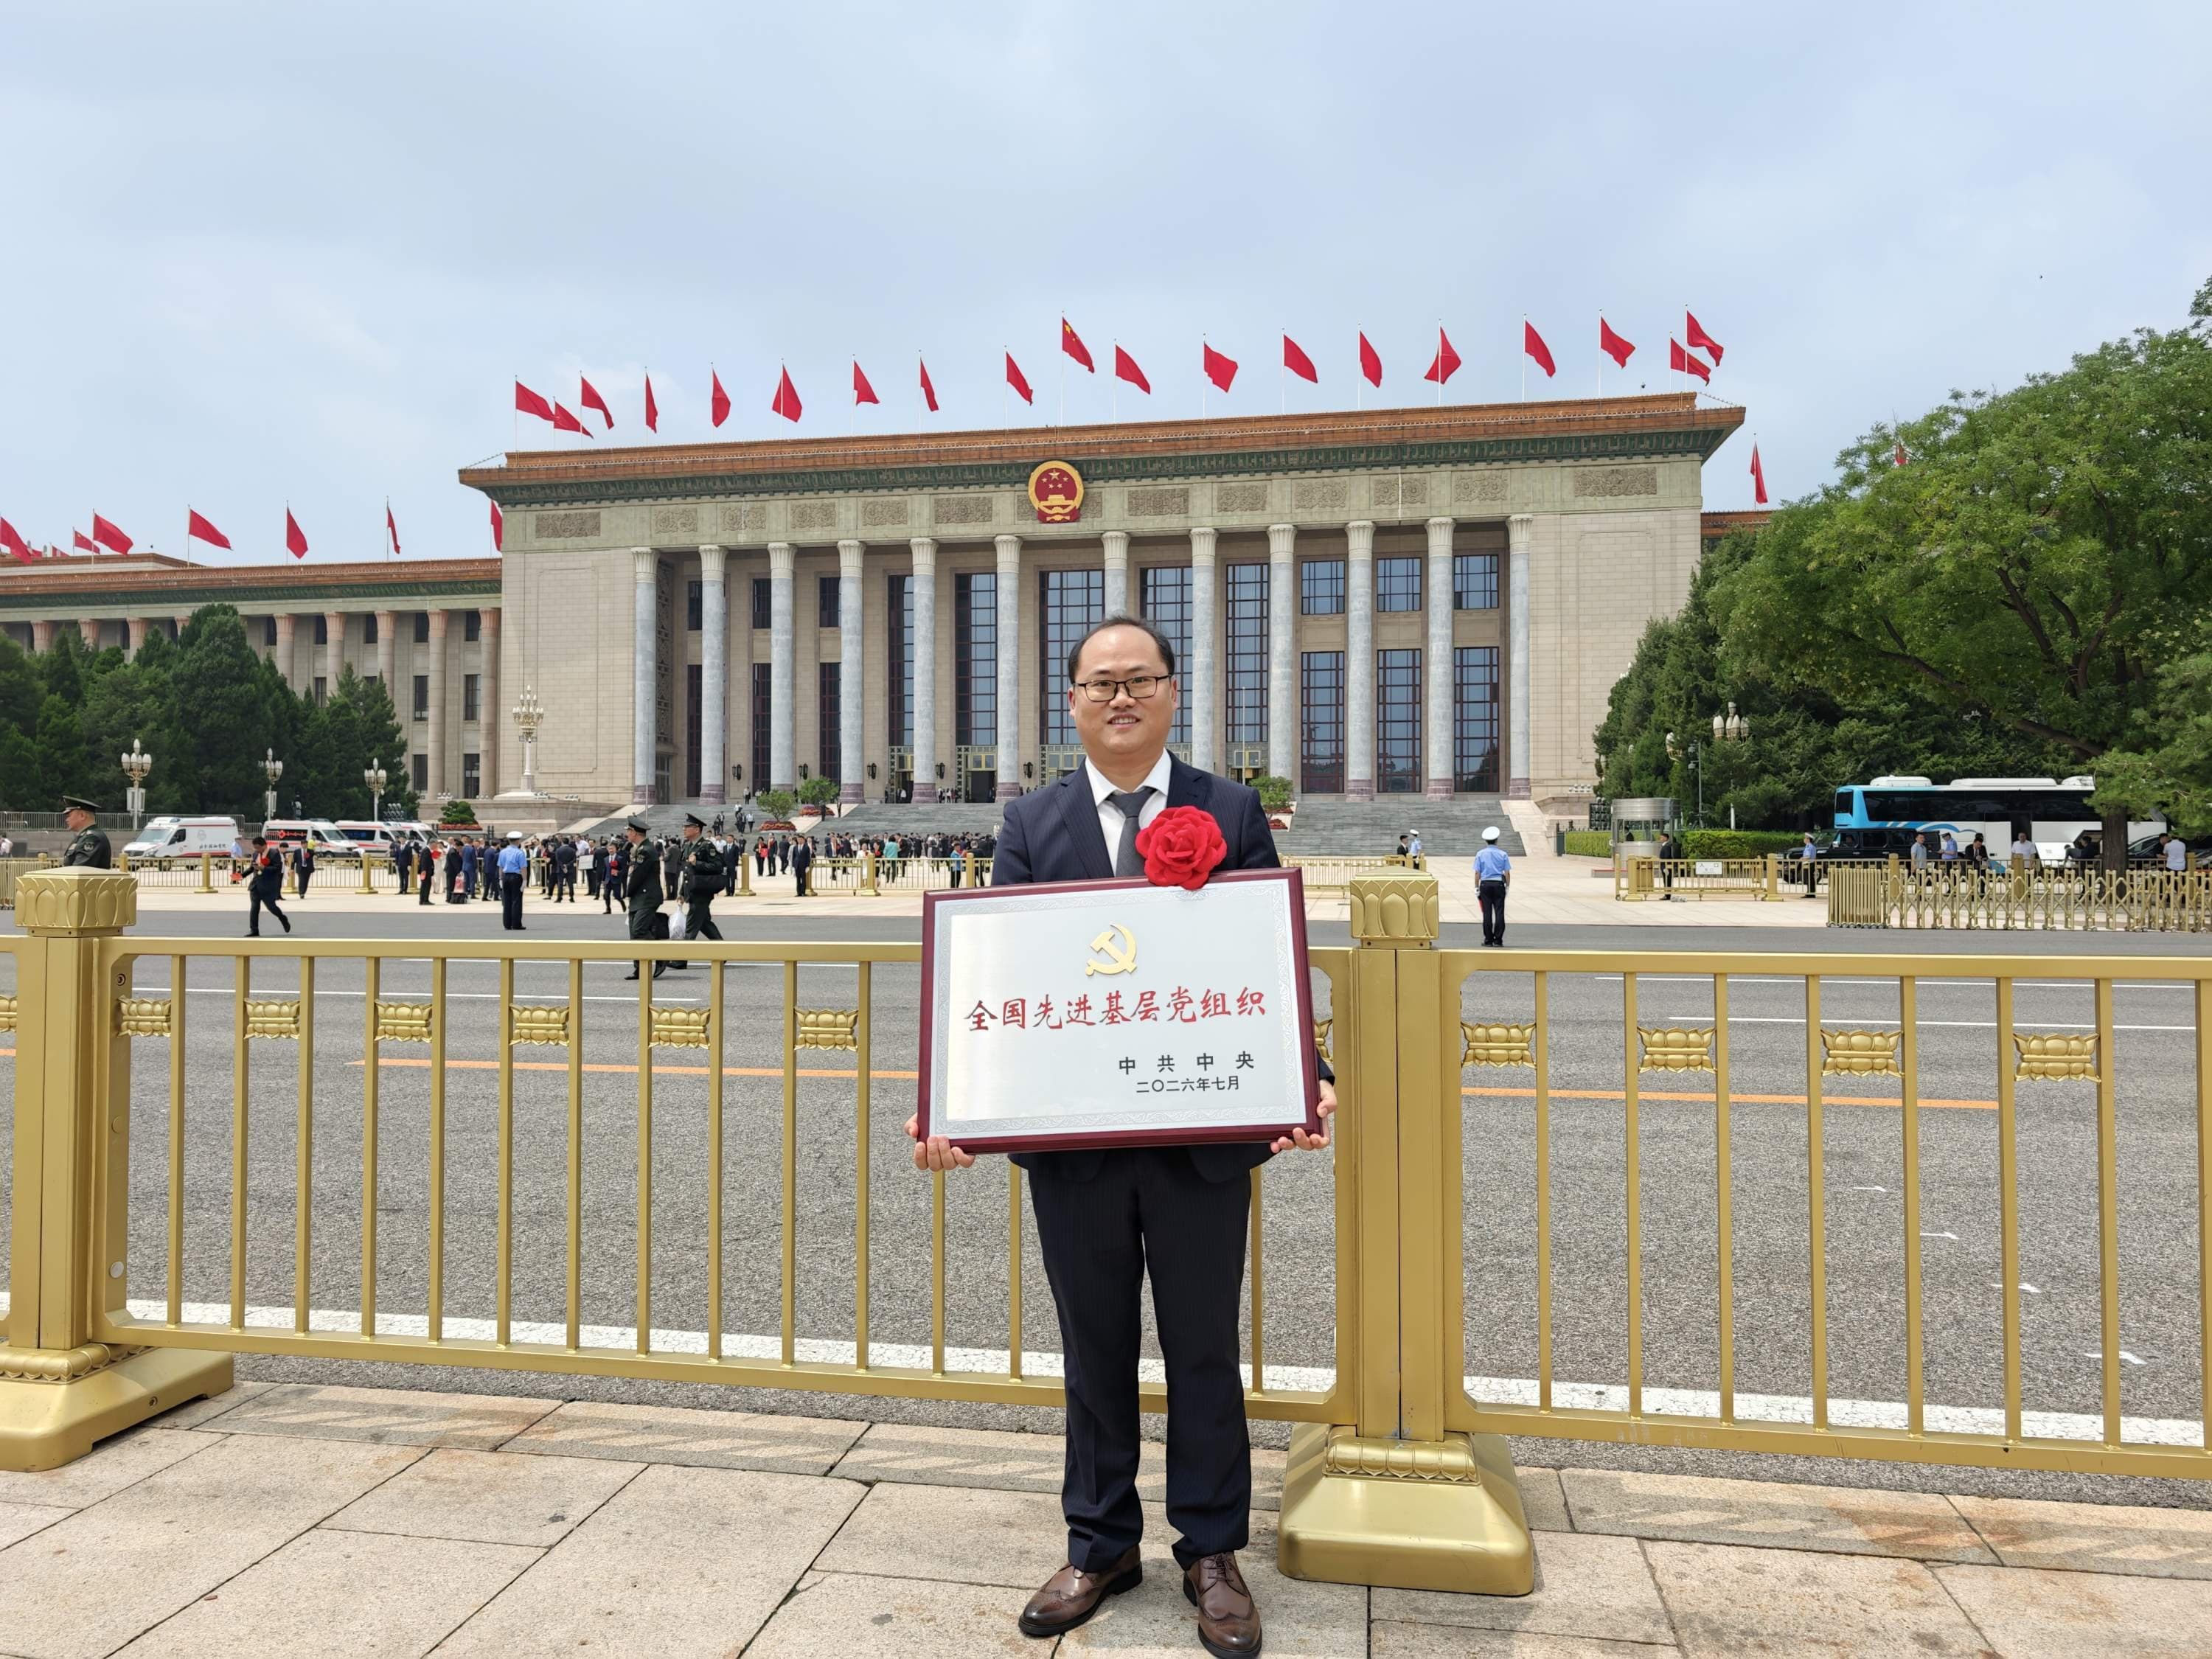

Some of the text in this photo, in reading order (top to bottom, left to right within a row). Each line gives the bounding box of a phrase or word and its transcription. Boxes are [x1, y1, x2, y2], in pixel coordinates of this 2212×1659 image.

[964, 986, 1266, 1032] 全国先进基层党组织
